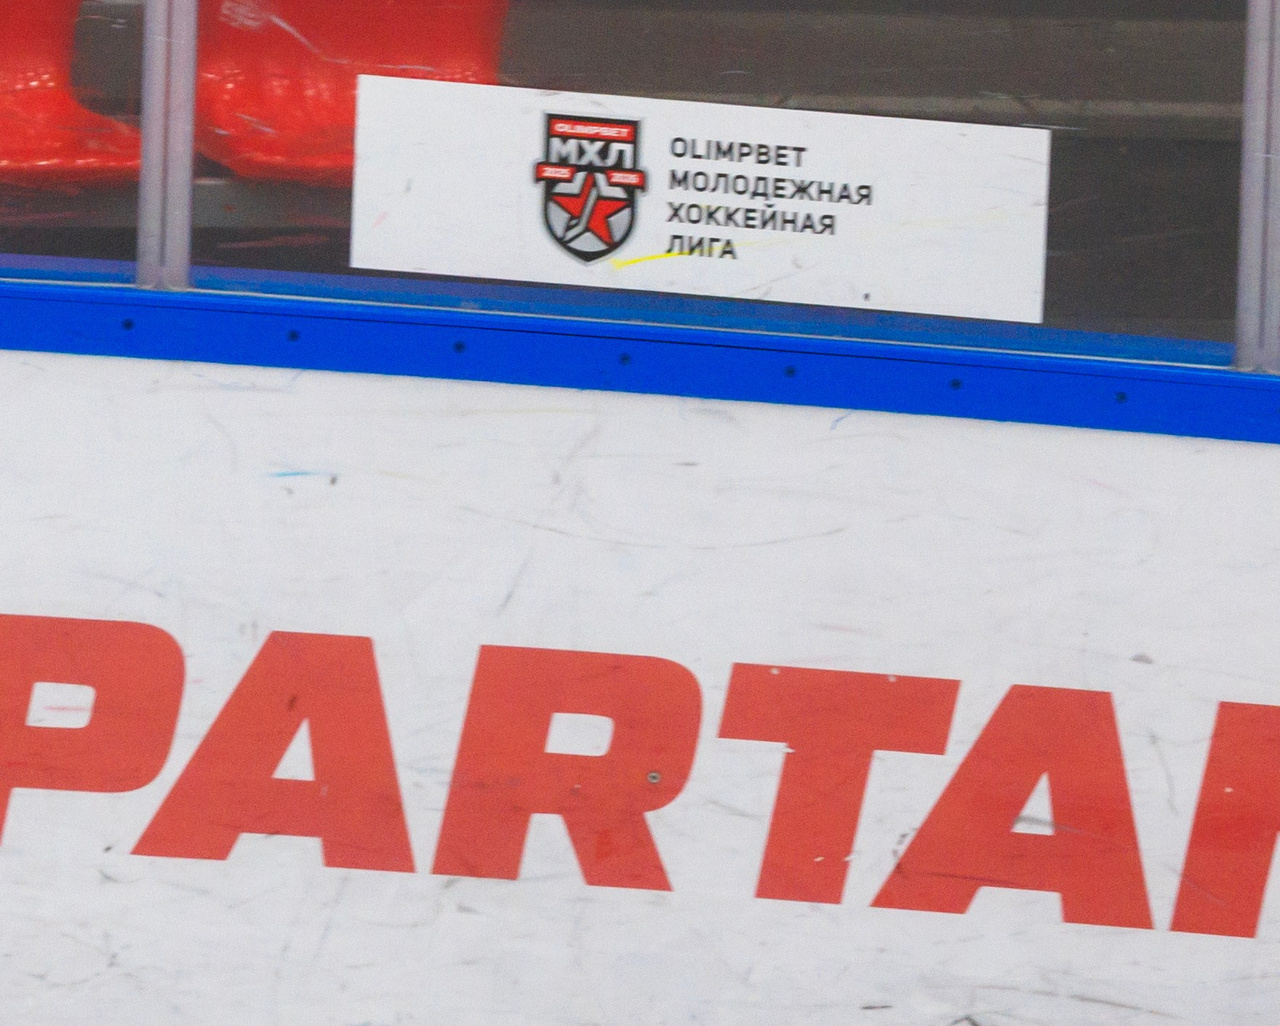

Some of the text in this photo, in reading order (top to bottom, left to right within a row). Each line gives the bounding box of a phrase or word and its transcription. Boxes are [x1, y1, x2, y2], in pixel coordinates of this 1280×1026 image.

[549, 137, 634, 169] МХЛ
[669, 136, 808, 168] OLIMPBET
[668, 169, 873, 206] МОЛОДЕЖНАЯ
[667, 201, 836, 236] ХОККЕЙНАЯ
[666, 234, 738, 260] ЛИГА
